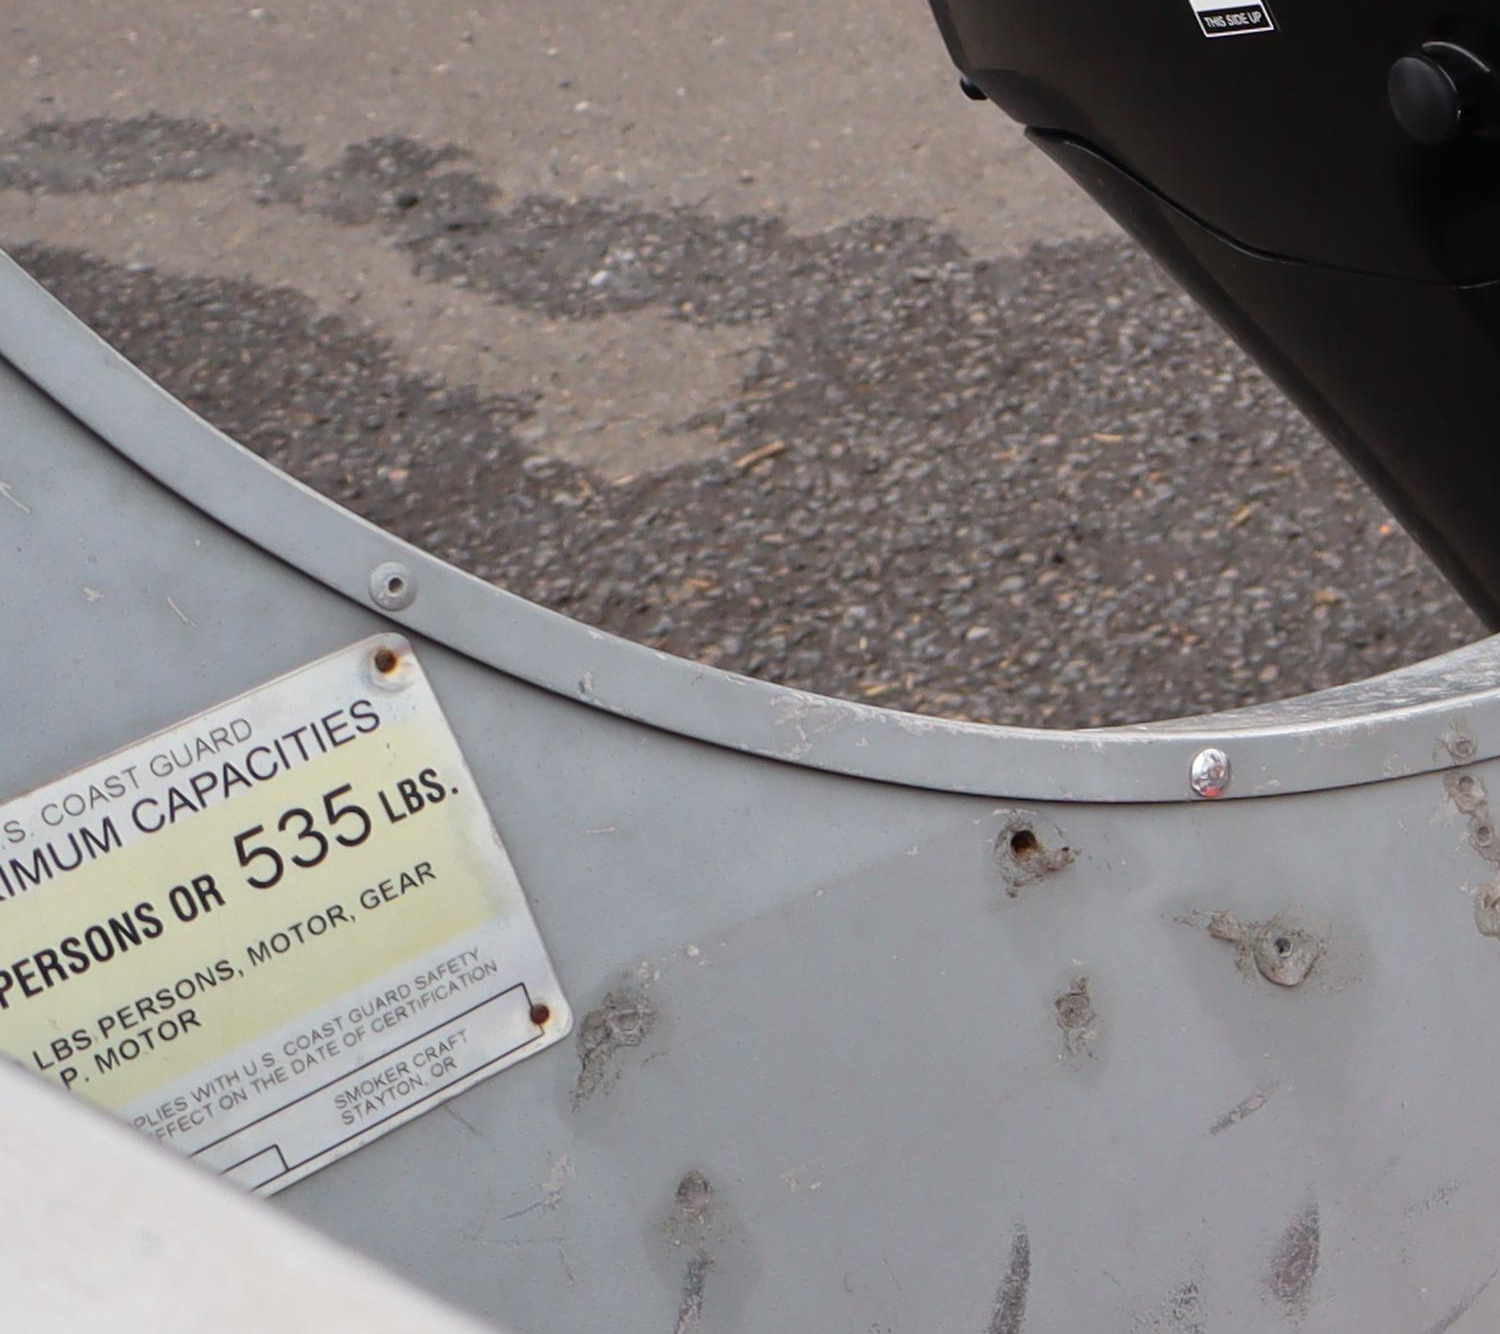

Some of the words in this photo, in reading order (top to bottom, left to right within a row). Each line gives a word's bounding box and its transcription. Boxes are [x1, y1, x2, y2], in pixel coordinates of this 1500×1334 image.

[1226, 13, 1249, 26] SIDE
[1248, 11, 1263, 23] UP
[41, 765, 139, 827] COAST
[149, 718, 253, 778] GUARD
[131, 699, 381, 834] CAPACITIES
[0, 901, 164, 1010] PERSONS
[168, 873, 226, 923] OR
[233, 782, 372, 890] 535
[377, 768, 459, 824] LBS.
[97, 958, 245, 1040] PERSONS,
[246, 904, 356, 967] MOTOR,
[359, 861, 437, 910] GEAR
[93, 1008, 202, 1075] MOTOR
[128, 1095, 188, 1130] PLIES
[190, 1069, 241, 1103] WITH
[283, 1015, 346, 1058] COAST
[347, 983, 412, 1025] GUARD
[414, 947, 481, 992] SAFETY
[147, 1103, 214, 1140] FFECT
[218, 1087, 249, 1112] ON
[250, 1066, 290, 1095] THE
[290, 1040, 341, 1076] DATE
[343, 1026, 369, 1049] OF
[370, 959, 499, 1035] CERTIFICATION
[333, 1060, 411, 1110] SMOKER
[412, 1028, 469, 1068] CRAFT
[430, 1055, 458, 1079] OR
